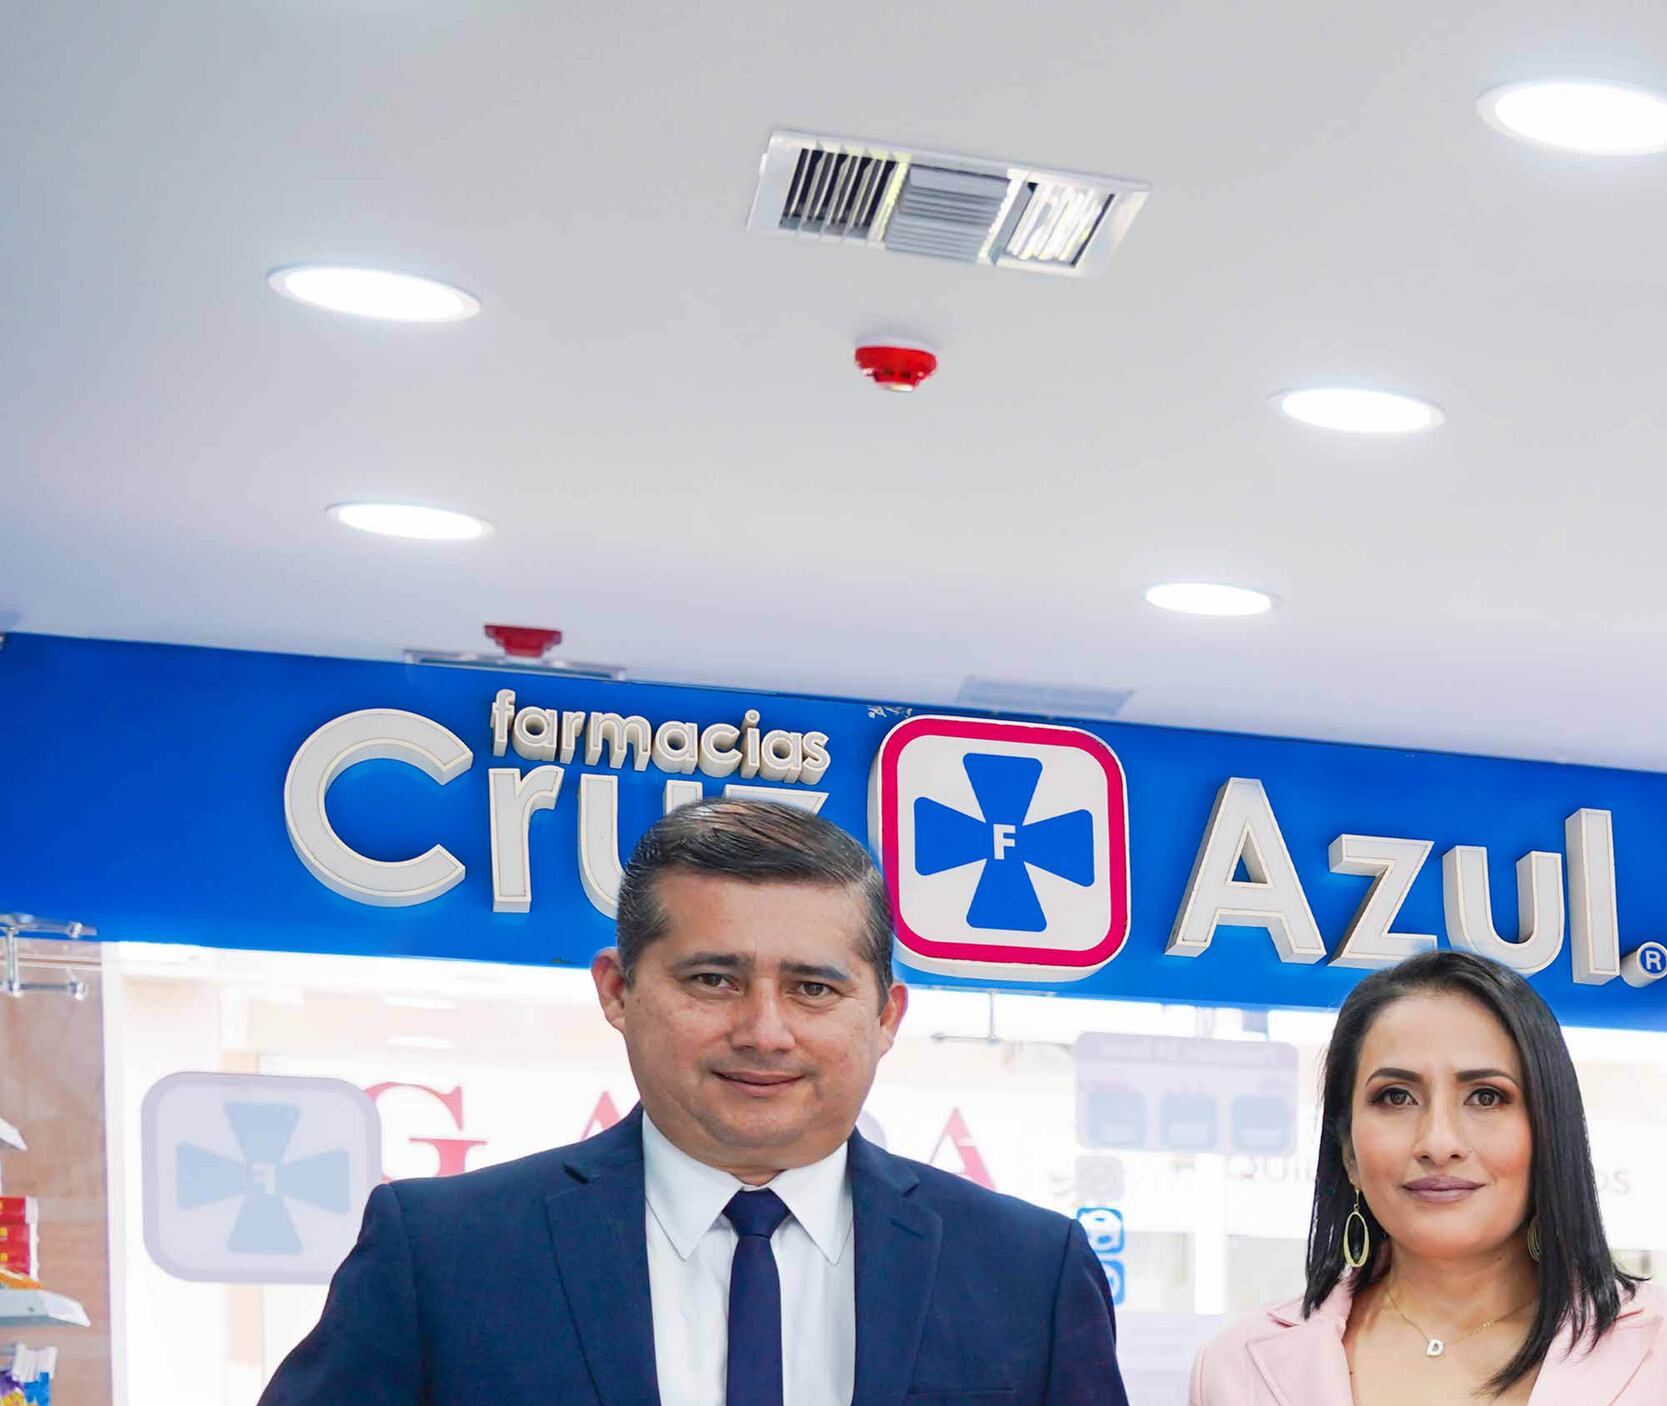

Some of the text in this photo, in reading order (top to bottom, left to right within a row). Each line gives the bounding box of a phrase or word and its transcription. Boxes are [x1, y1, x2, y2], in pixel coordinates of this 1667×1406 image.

[491, 689, 831, 786] farmacias
[284, 709, 830, 920] Cru
[993, 826, 1015, 860] F
[1166, 777, 1621, 987] Azul
